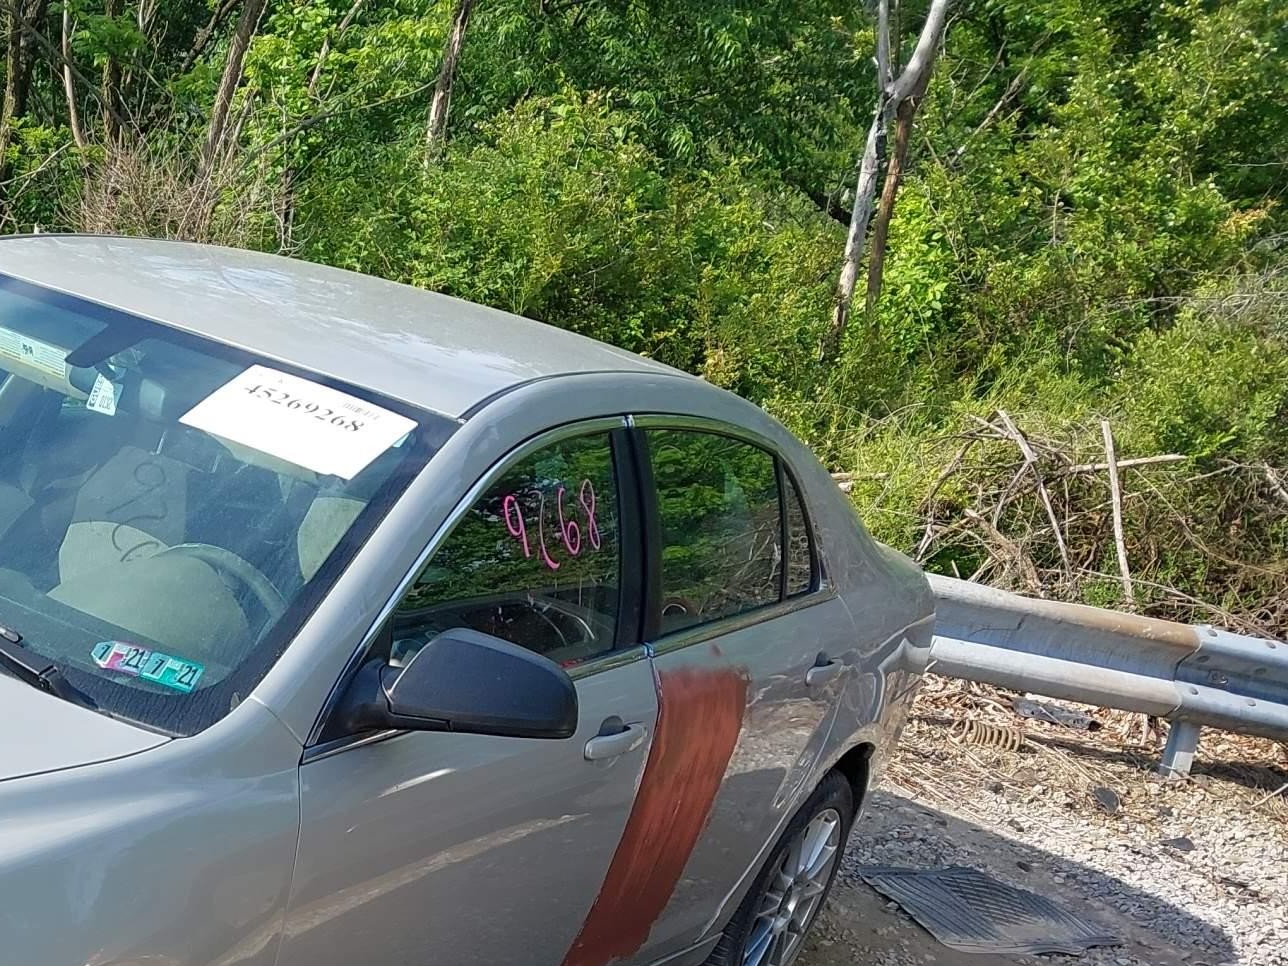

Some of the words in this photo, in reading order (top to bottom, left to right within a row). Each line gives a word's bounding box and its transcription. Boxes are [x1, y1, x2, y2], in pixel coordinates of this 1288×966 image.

[244, 383, 366, 433] 45269268
[99, 645, 111, 660] 7
[125, 648, 145, 669] 21
[151, 659, 164, 675] 7
[177, 666, 198, 686] 21
